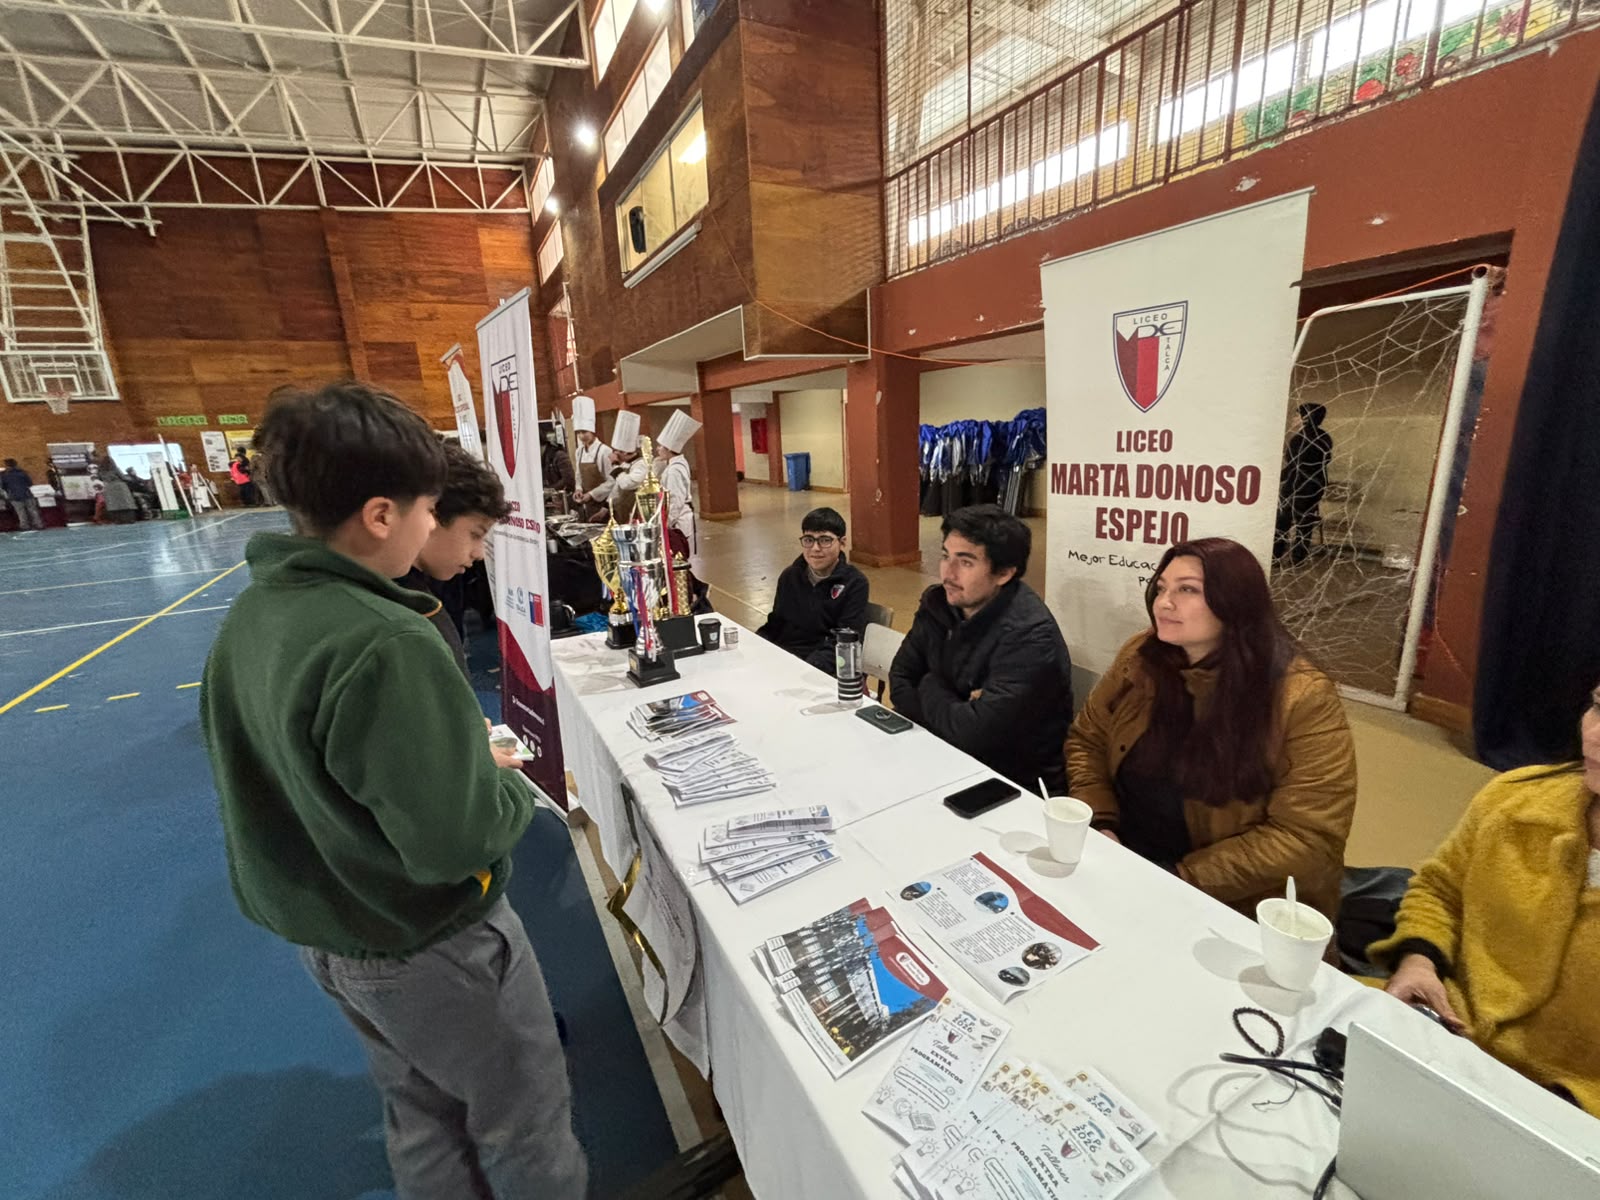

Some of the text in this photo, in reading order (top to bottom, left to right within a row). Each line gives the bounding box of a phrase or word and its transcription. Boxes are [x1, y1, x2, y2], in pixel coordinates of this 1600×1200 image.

[1133, 313, 1168, 325] LICEO
[1116, 429, 1173, 453] LICEO
[1051, 463, 1261, 506] MARTA DONOSO
[1095, 507, 1189, 546] ESPEJO
[1068, 549, 1105, 565] Mejor
[951, 1017, 973, 1033] 2026
[930, 1050, 952, 1067] EXTRA
[932, 1039, 960, 1061] Talleres
[1071, 1125, 1098, 1153] 2026
[1035, 1155, 1060, 1189] EXTRA
[1040, 1143, 1071, 1184] Talleres
